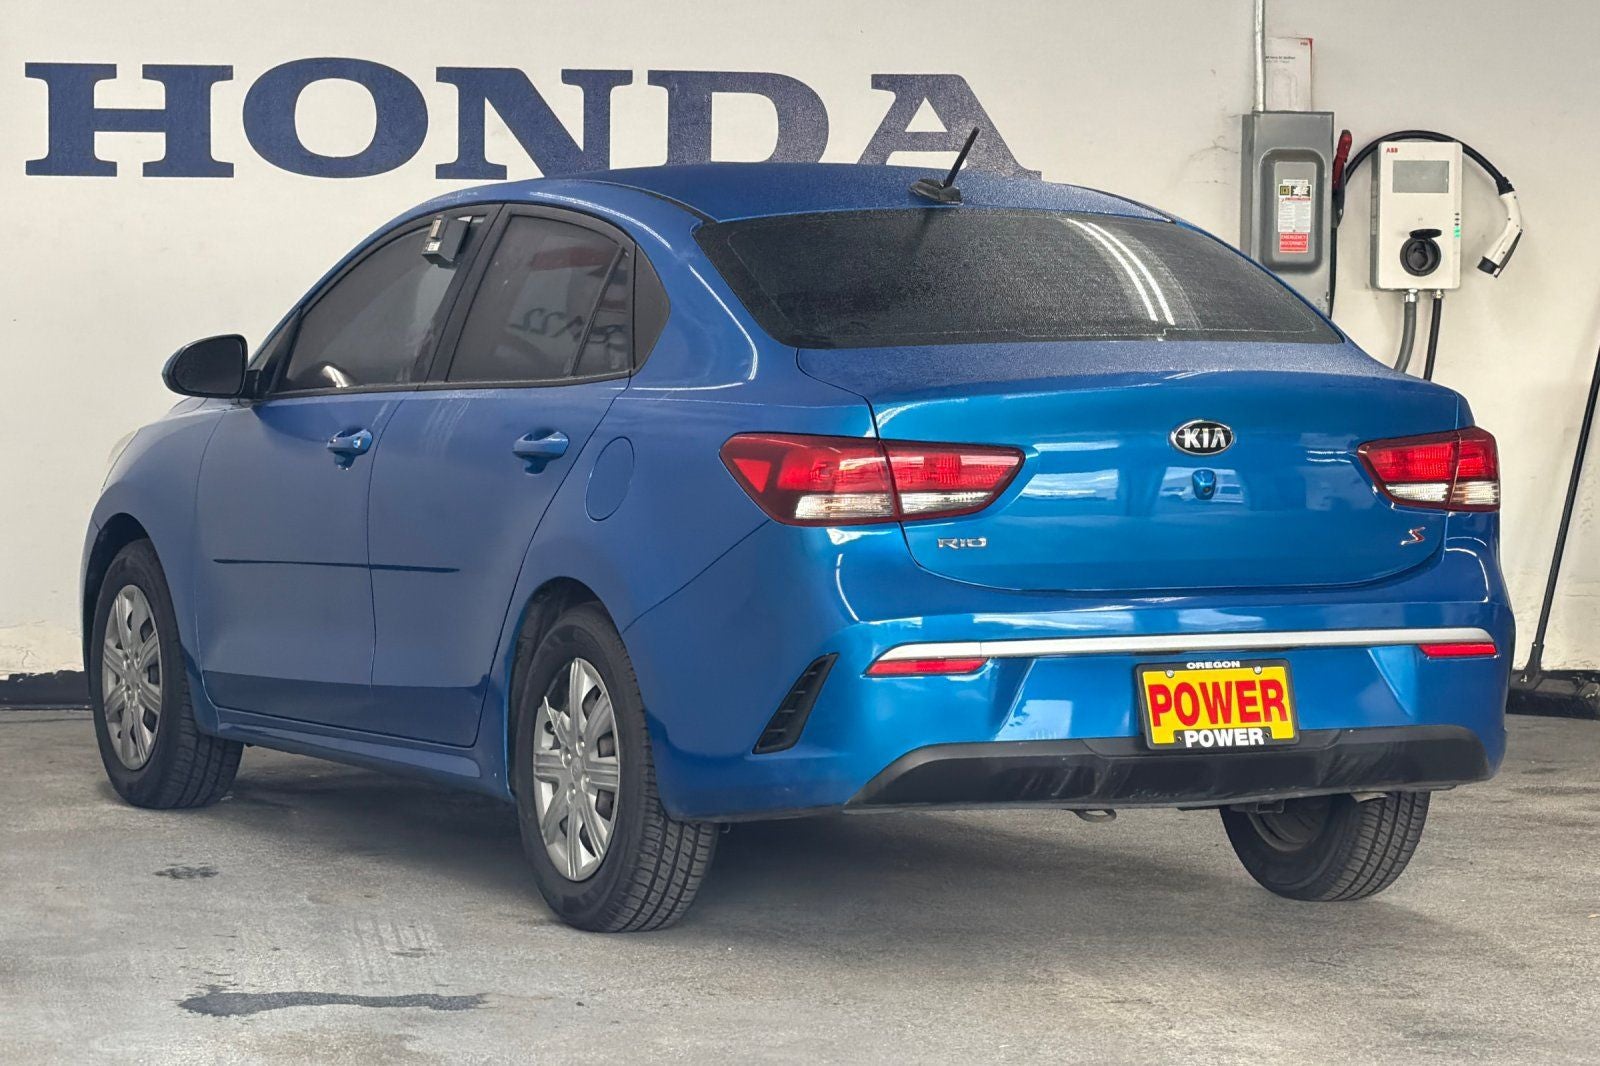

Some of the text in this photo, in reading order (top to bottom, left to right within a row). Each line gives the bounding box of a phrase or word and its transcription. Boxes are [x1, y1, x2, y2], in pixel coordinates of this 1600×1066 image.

[25, 58, 1041, 180] HONDA
[1184, 427, 1227, 448] KIA
[937, 537, 987, 549] RIO
[1400, 526, 1426, 546] S
[1186, 660, 1240, 669] OREGON
[1147, 678, 1288, 727] POWER
[1183, 728, 1265, 748] POWER
